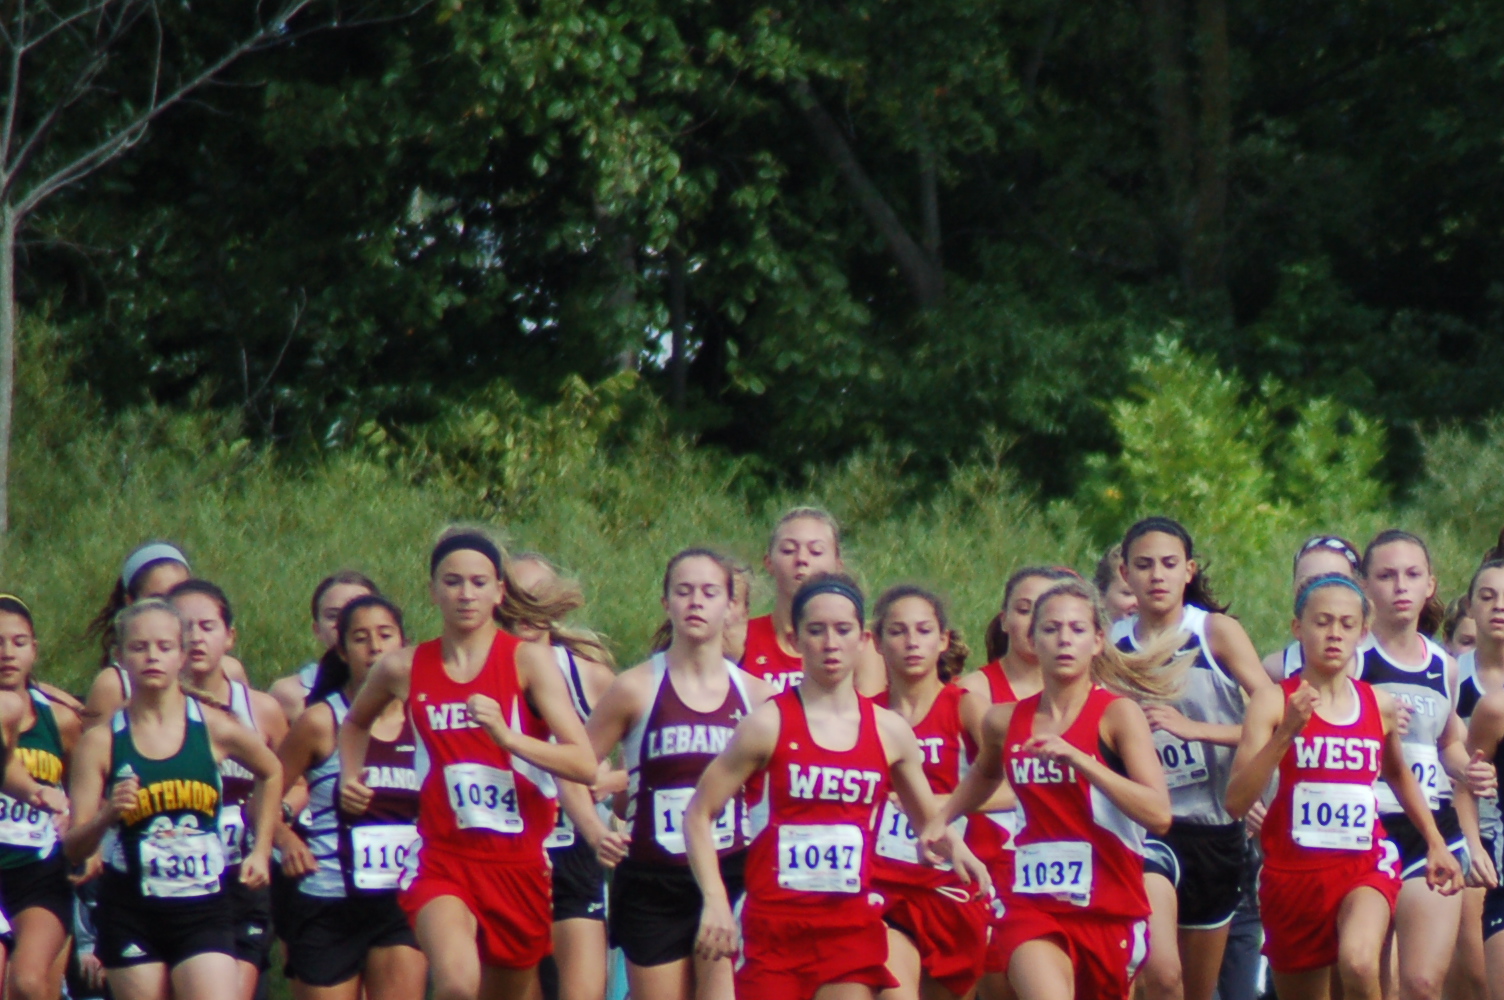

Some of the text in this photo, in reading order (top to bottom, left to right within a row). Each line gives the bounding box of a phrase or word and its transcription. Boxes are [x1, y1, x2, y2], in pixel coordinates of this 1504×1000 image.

[1294, 736, 1381, 772] WEST
[788, 763, 882, 804] WEST
[1011, 758, 1077, 784] WEST
[453, 782, 517, 813] 1034
[1301, 801, 1367, 828] 1042
[149, 852, 211, 879] 1301
[788, 844, 855, 870] 1047
[1022, 860, 1084, 888] 1037
